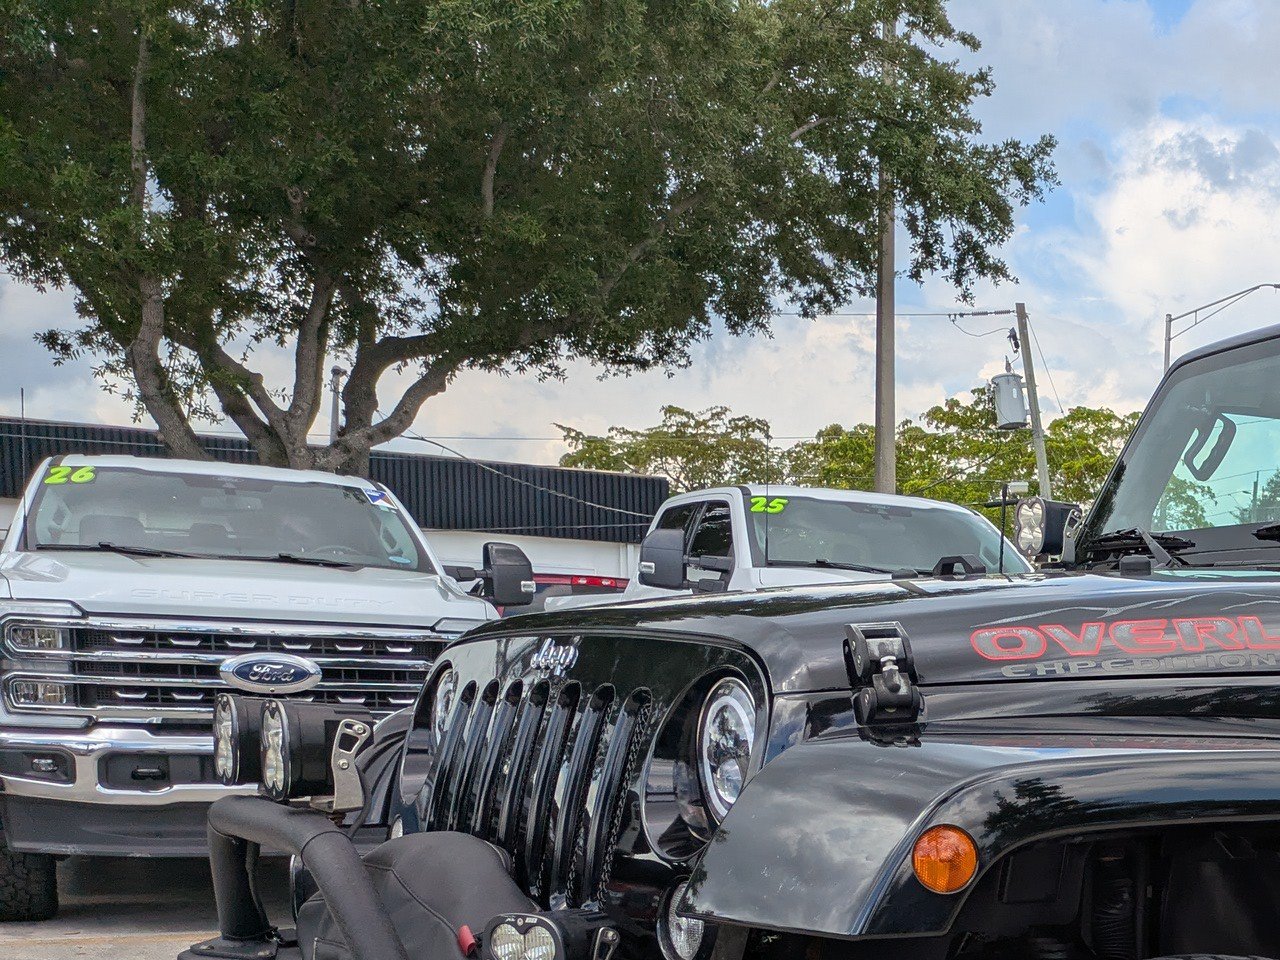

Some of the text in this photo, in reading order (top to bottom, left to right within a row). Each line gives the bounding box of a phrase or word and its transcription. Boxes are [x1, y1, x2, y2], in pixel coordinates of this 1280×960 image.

[44, 466, 95, 485] 26
[750, 496, 789, 513] 25
[130, 588, 396, 609] SUPER DUTY
[531, 637, 579, 677] Jeep
[1001, 653, 1277, 678] EXPEDITION
[248, 664, 295, 681] Ford
